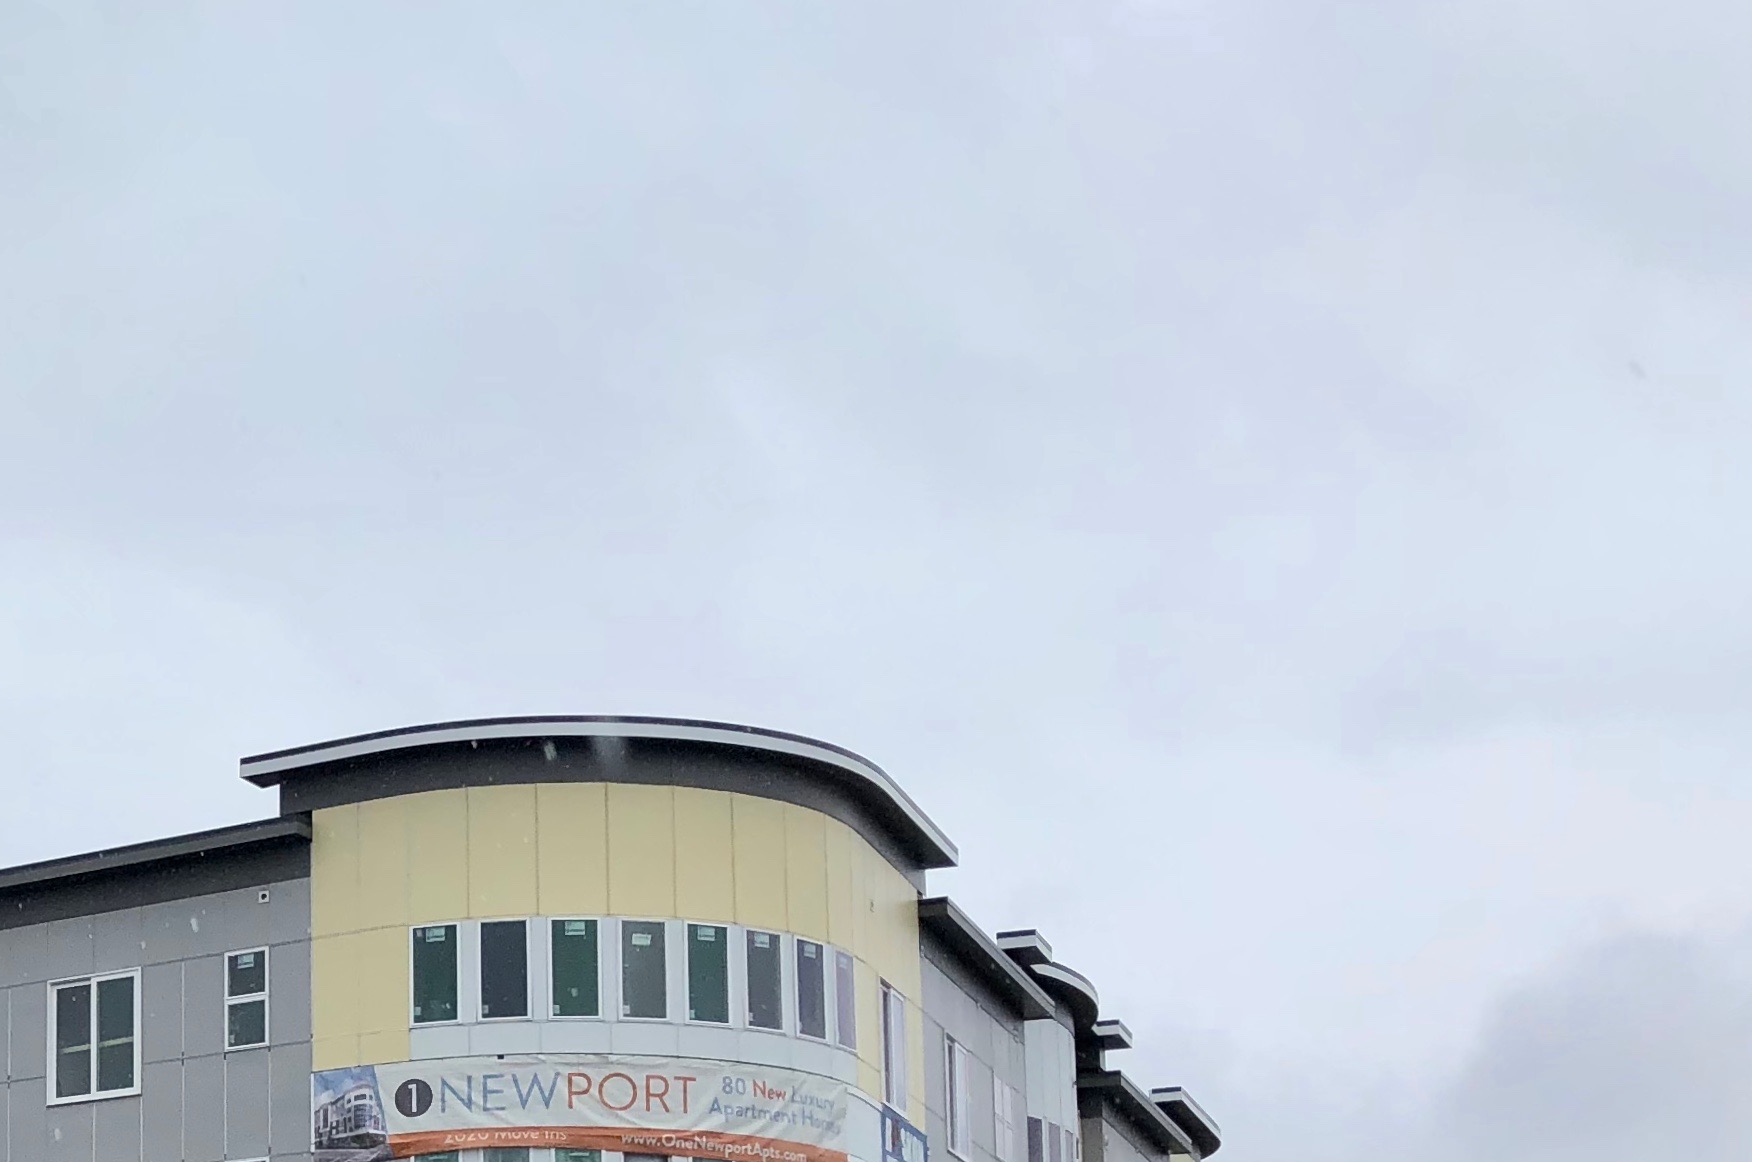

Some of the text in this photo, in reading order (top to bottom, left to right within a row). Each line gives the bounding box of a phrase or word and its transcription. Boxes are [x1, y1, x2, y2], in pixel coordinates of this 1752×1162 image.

[440, 1071, 697, 1114] NEWPORT
[722, 1075, 747, 1096] 80
[752, 1079, 787, 1101] New
[709, 1096, 797, 1125] Apartment
[621, 1133, 807, 1162] www.OneNewportApts.com
